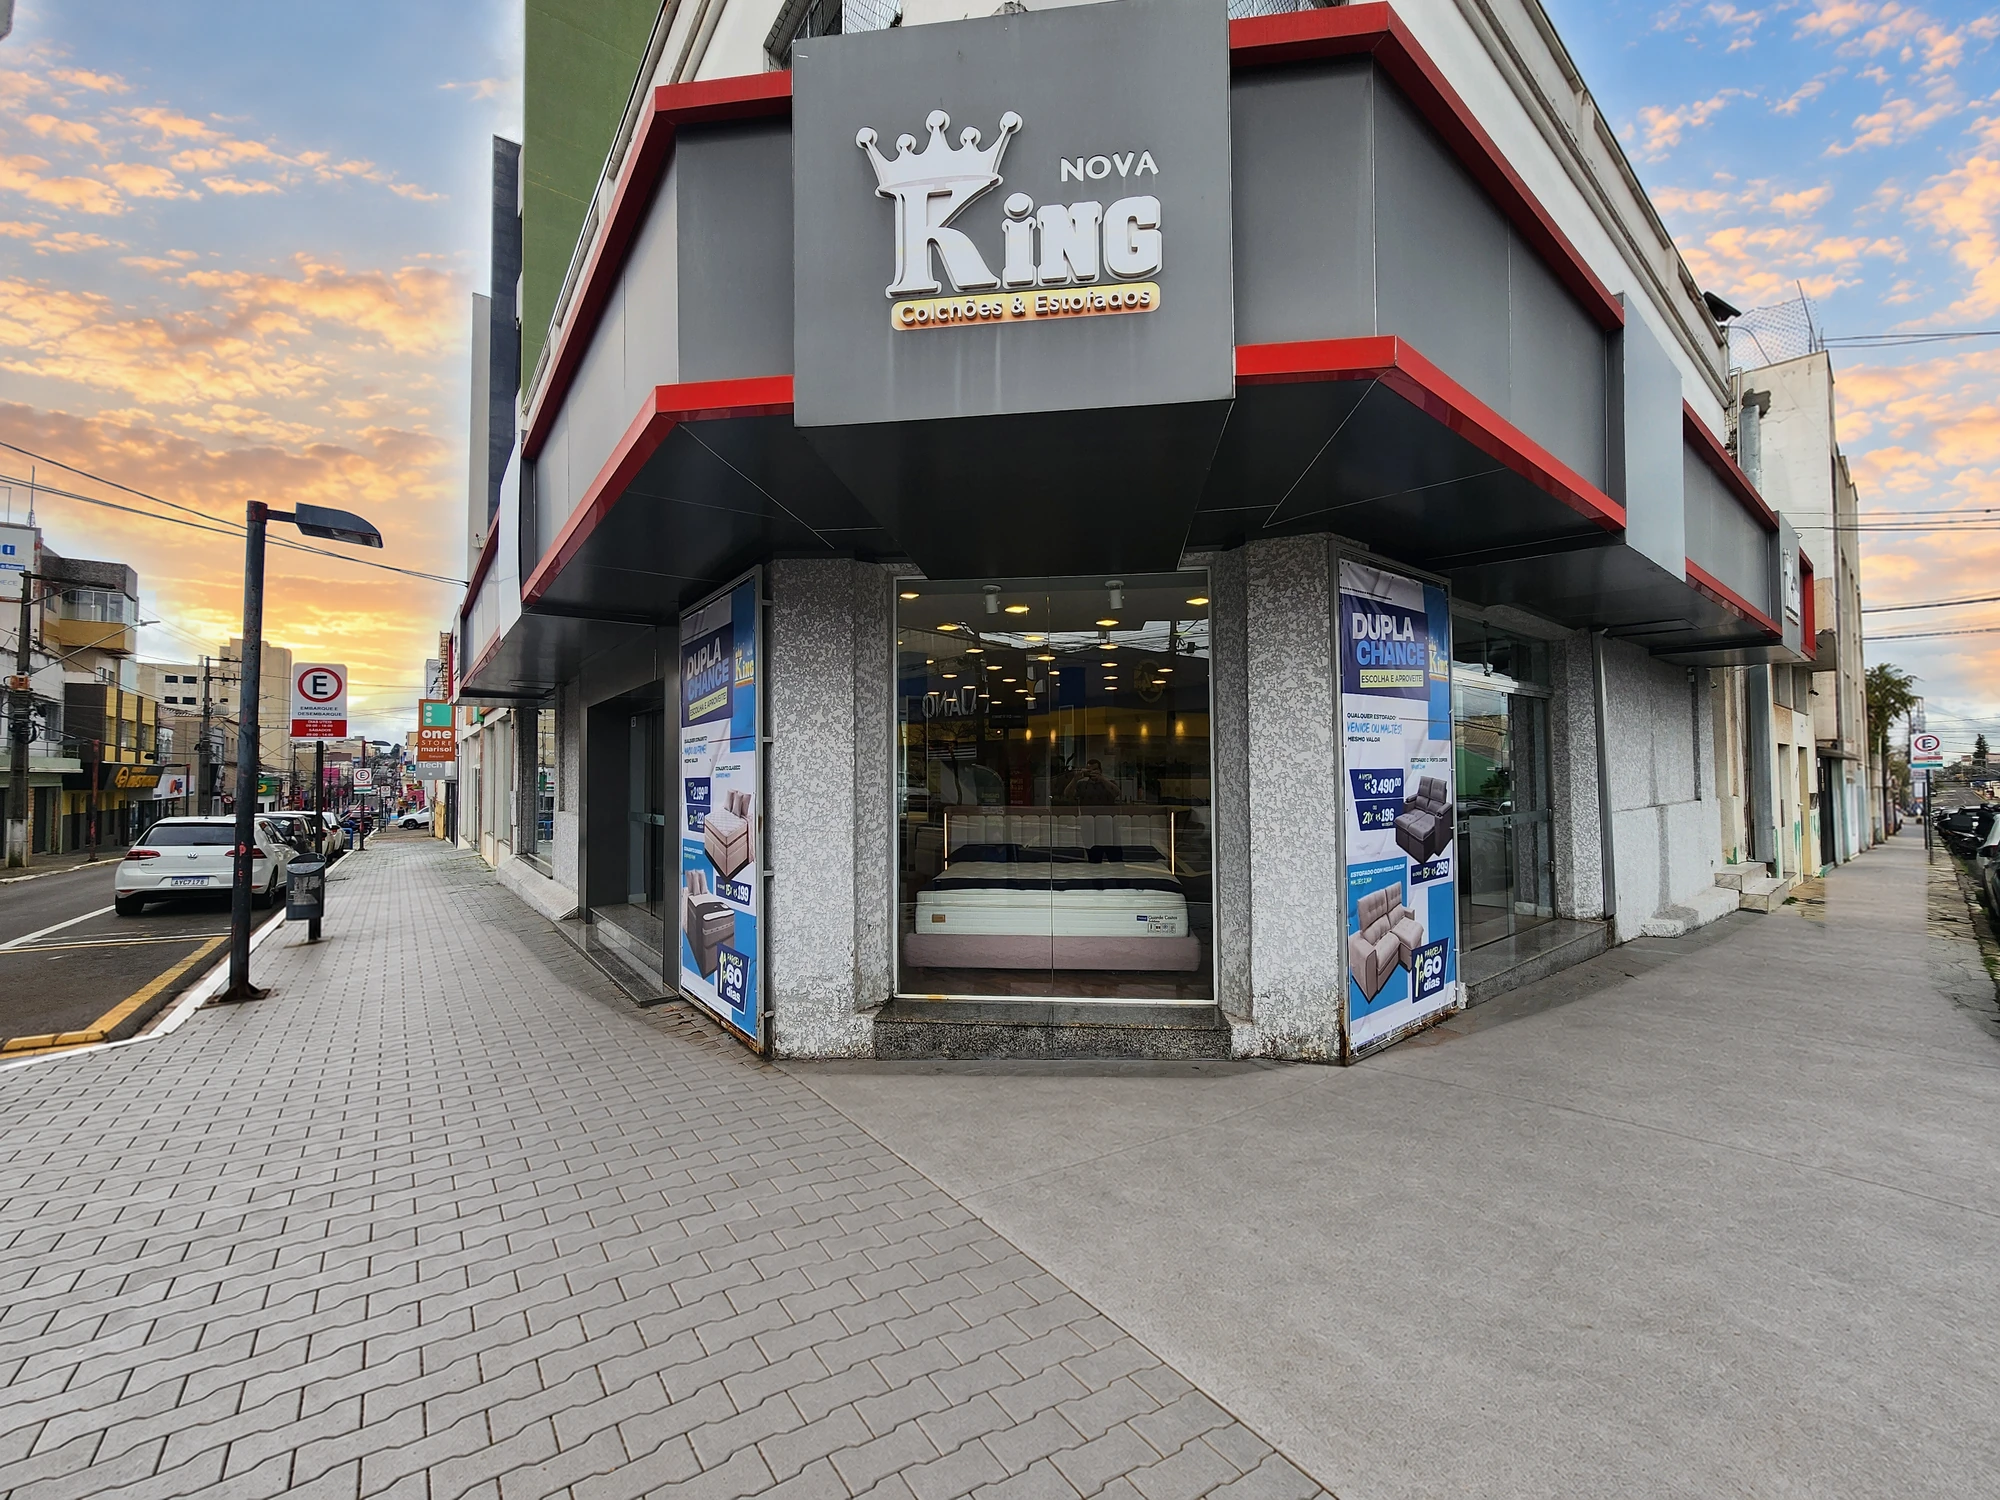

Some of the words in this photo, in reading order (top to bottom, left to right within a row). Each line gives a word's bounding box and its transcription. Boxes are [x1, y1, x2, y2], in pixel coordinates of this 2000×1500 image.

[1060, 150, 1160, 182] NOVA
[898, 299, 1004, 325] Colchões
[1010, 296, 1027, 317] &
[1034, 289, 1152, 313] Estofados
[1352, 612, 1415, 642] DUPLA
[686, 636, 722, 681] DUPLA
[1356, 641, 1425, 666] CHANCE
[312, 675, 328, 695] E
[687, 657, 729, 700] CHANCE
[1361, 674, 1389, 684] ESCOLHA
[1390, 675, 1395, 683] E
[421, 729, 452, 739] one
[1371, 723, 1380, 733] OU
[1922, 738, 1932, 748] E
[1381, 808, 1395, 822] 196
[1436, 861, 1449, 875] 299
[737, 884, 750, 902] 199
[726, 963, 743, 989] 60
[1424, 955, 1442, 978] 60
[1423, 977, 1441, 992] dias
[726, 985, 741, 1004] dias
